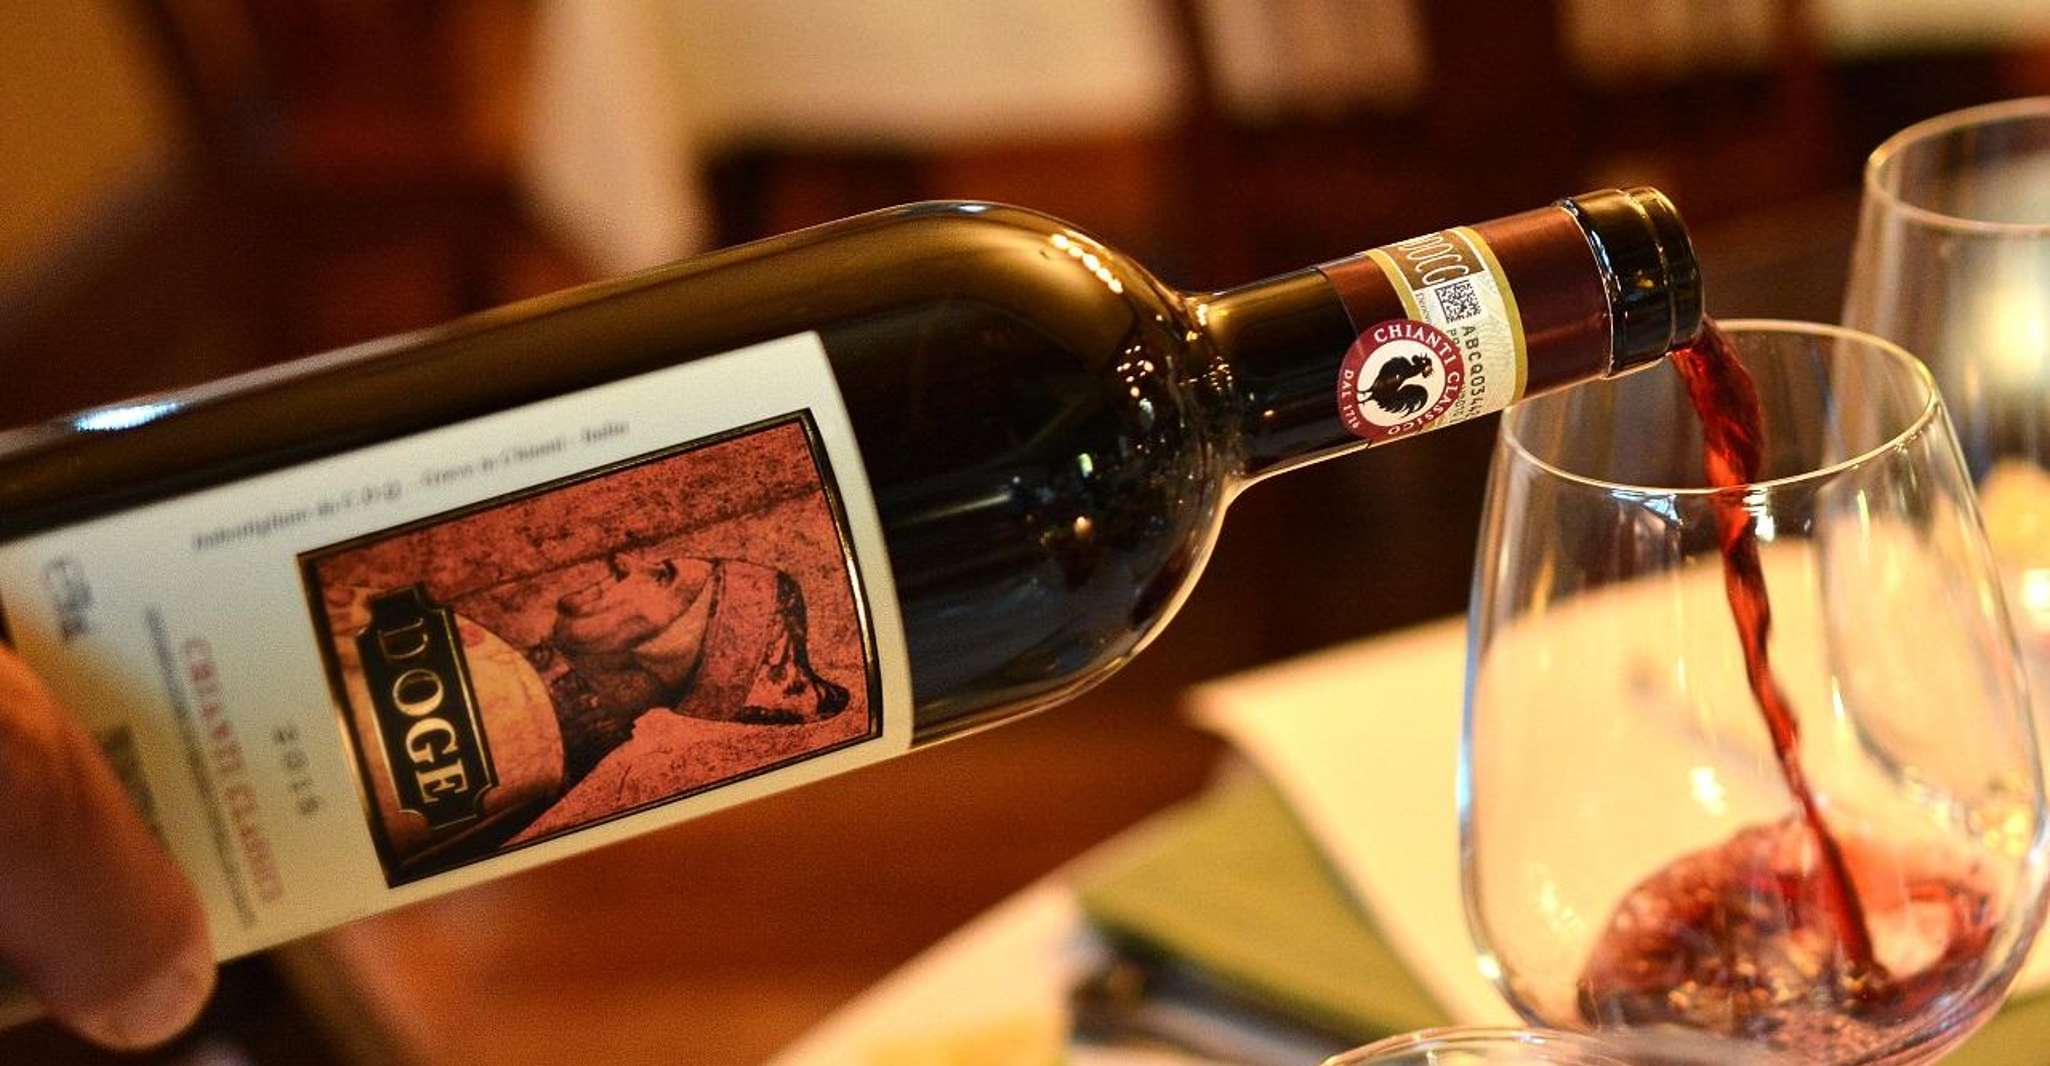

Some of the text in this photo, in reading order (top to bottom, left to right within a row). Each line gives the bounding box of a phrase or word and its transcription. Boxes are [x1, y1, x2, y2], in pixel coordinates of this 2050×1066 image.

[1341, 369, 1362, 429] DAL 1716
[1373, 324, 1460, 435] CHIANTI CLASSICO
[378, 617, 469, 804] DOGE
